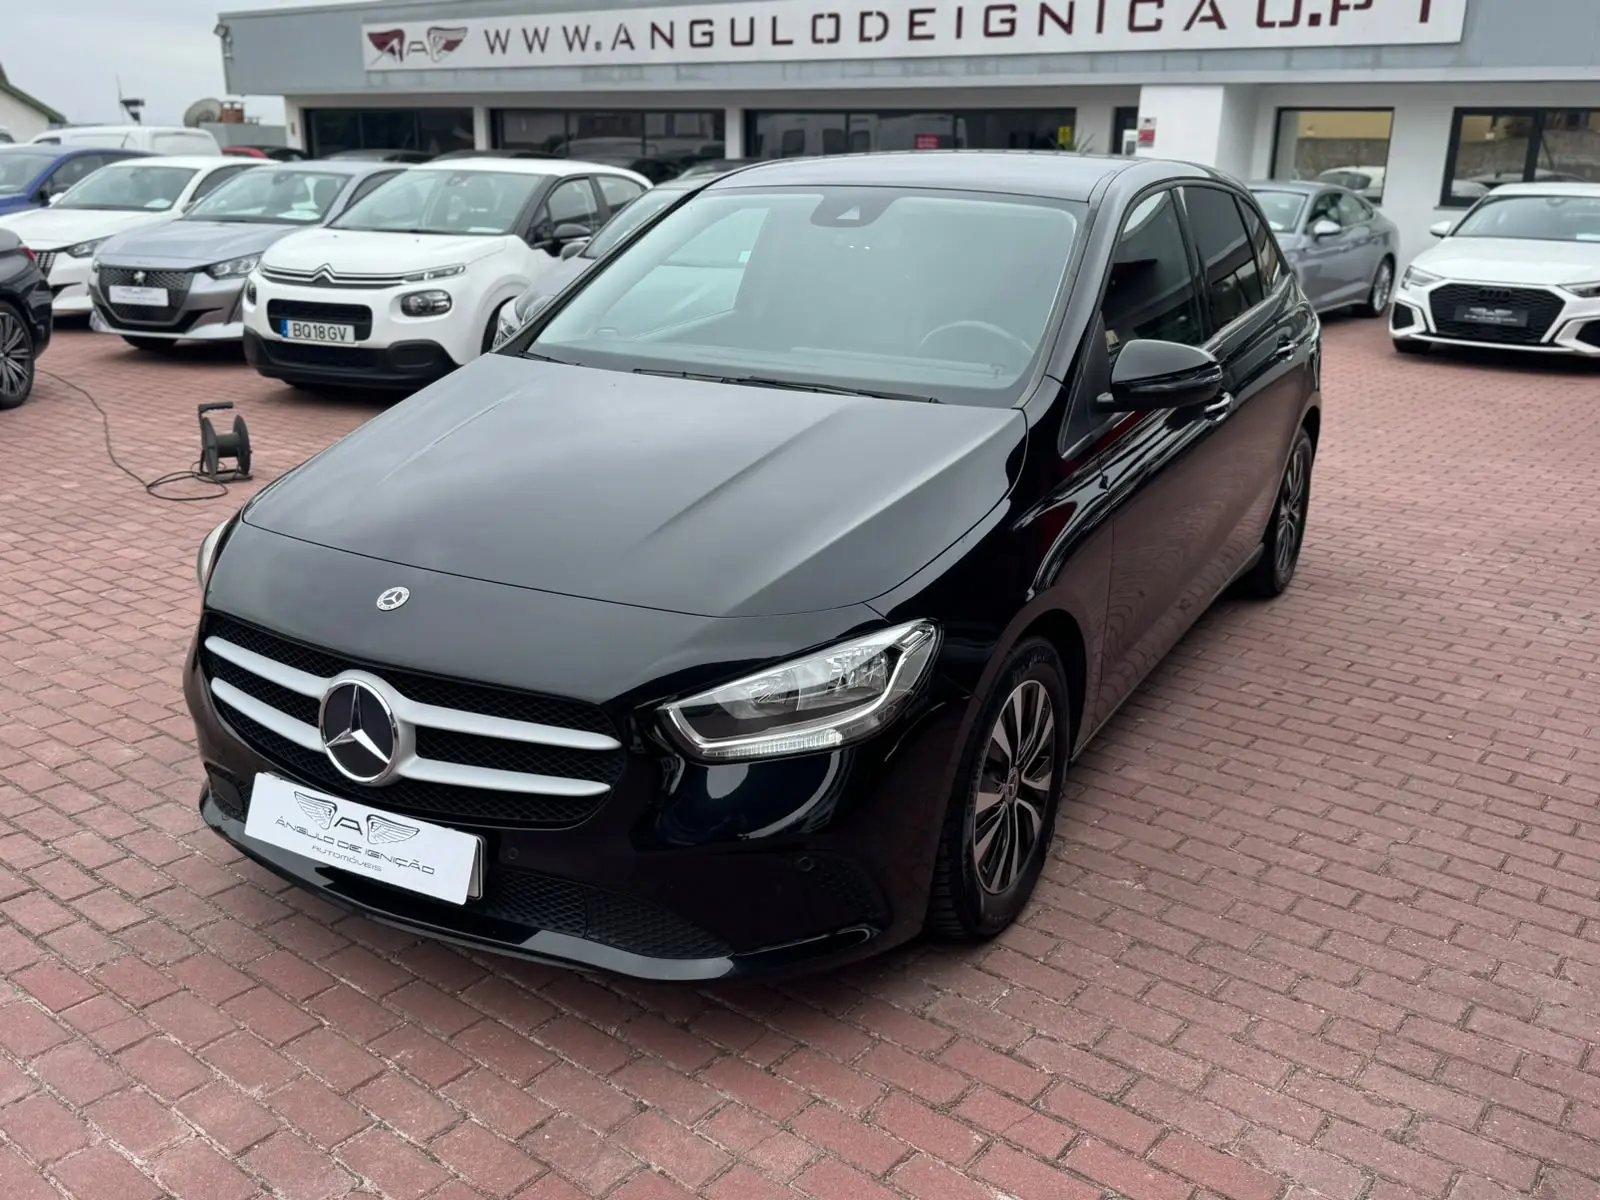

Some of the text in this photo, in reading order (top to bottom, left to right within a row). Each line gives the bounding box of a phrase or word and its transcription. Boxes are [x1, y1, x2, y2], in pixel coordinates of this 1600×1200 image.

[274, 815, 435, 875] ÂNGULO DE IGNIÇÃO
